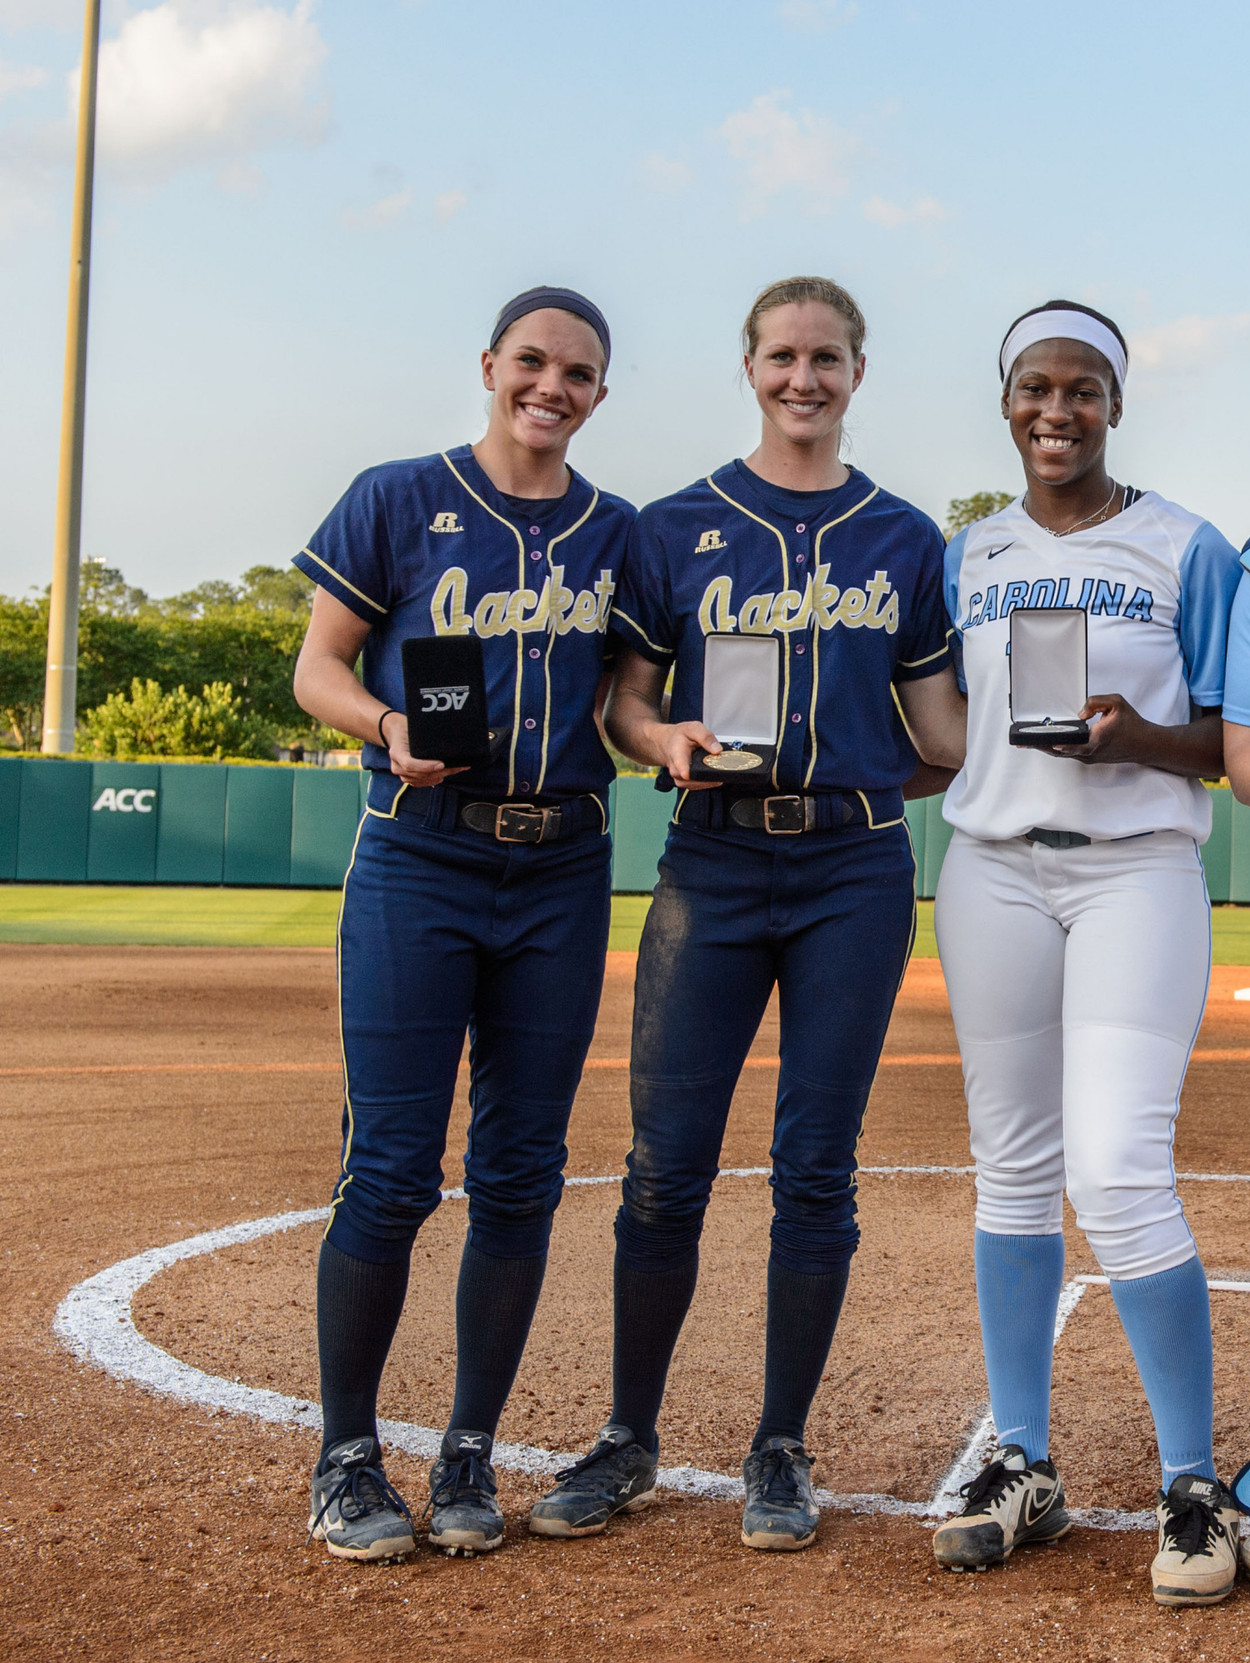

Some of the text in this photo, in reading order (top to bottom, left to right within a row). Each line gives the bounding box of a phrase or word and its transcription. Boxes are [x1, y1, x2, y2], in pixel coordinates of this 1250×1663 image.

[430, 565, 615, 638] Jacket
[698, 563, 899, 635] Jackets
[961, 577, 1154, 631] CAROLINA
[421, 691, 470, 713] ACC
[92, 787, 156, 813] ACC
[1188, 1481, 1214, 1496] NIKE
